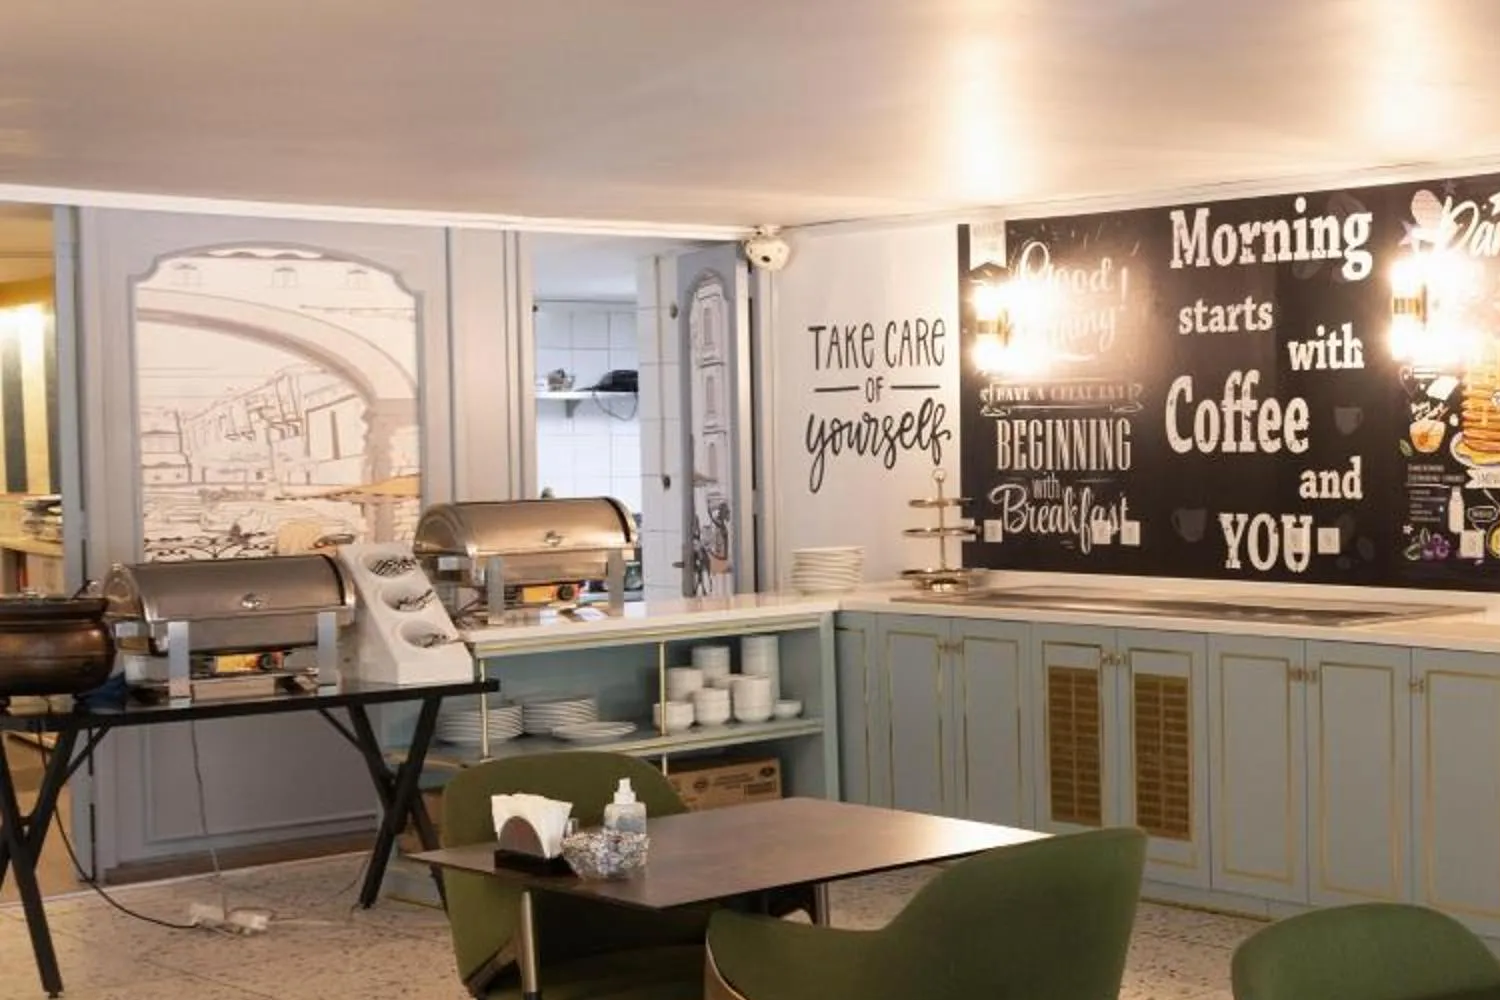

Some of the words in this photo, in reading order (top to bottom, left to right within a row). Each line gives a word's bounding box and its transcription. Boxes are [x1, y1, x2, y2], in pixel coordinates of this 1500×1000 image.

[1170, 197, 1373, 281] Morning
[1179, 297, 1274, 335] starts
[1289, 324, 1365, 371] with
[865, 376, 884, 402] OF
[1165, 370, 1310, 455] Coffee
[806, 397, 952, 493] yourself
[996, 417, 1132, 472] BEGINNING
[1032, 472, 1061, 499] with
[1300, 456, 1363, 500] and
[988, 483, 1129, 555] Breakfast
[1220, 512, 1315, 573] YOU
